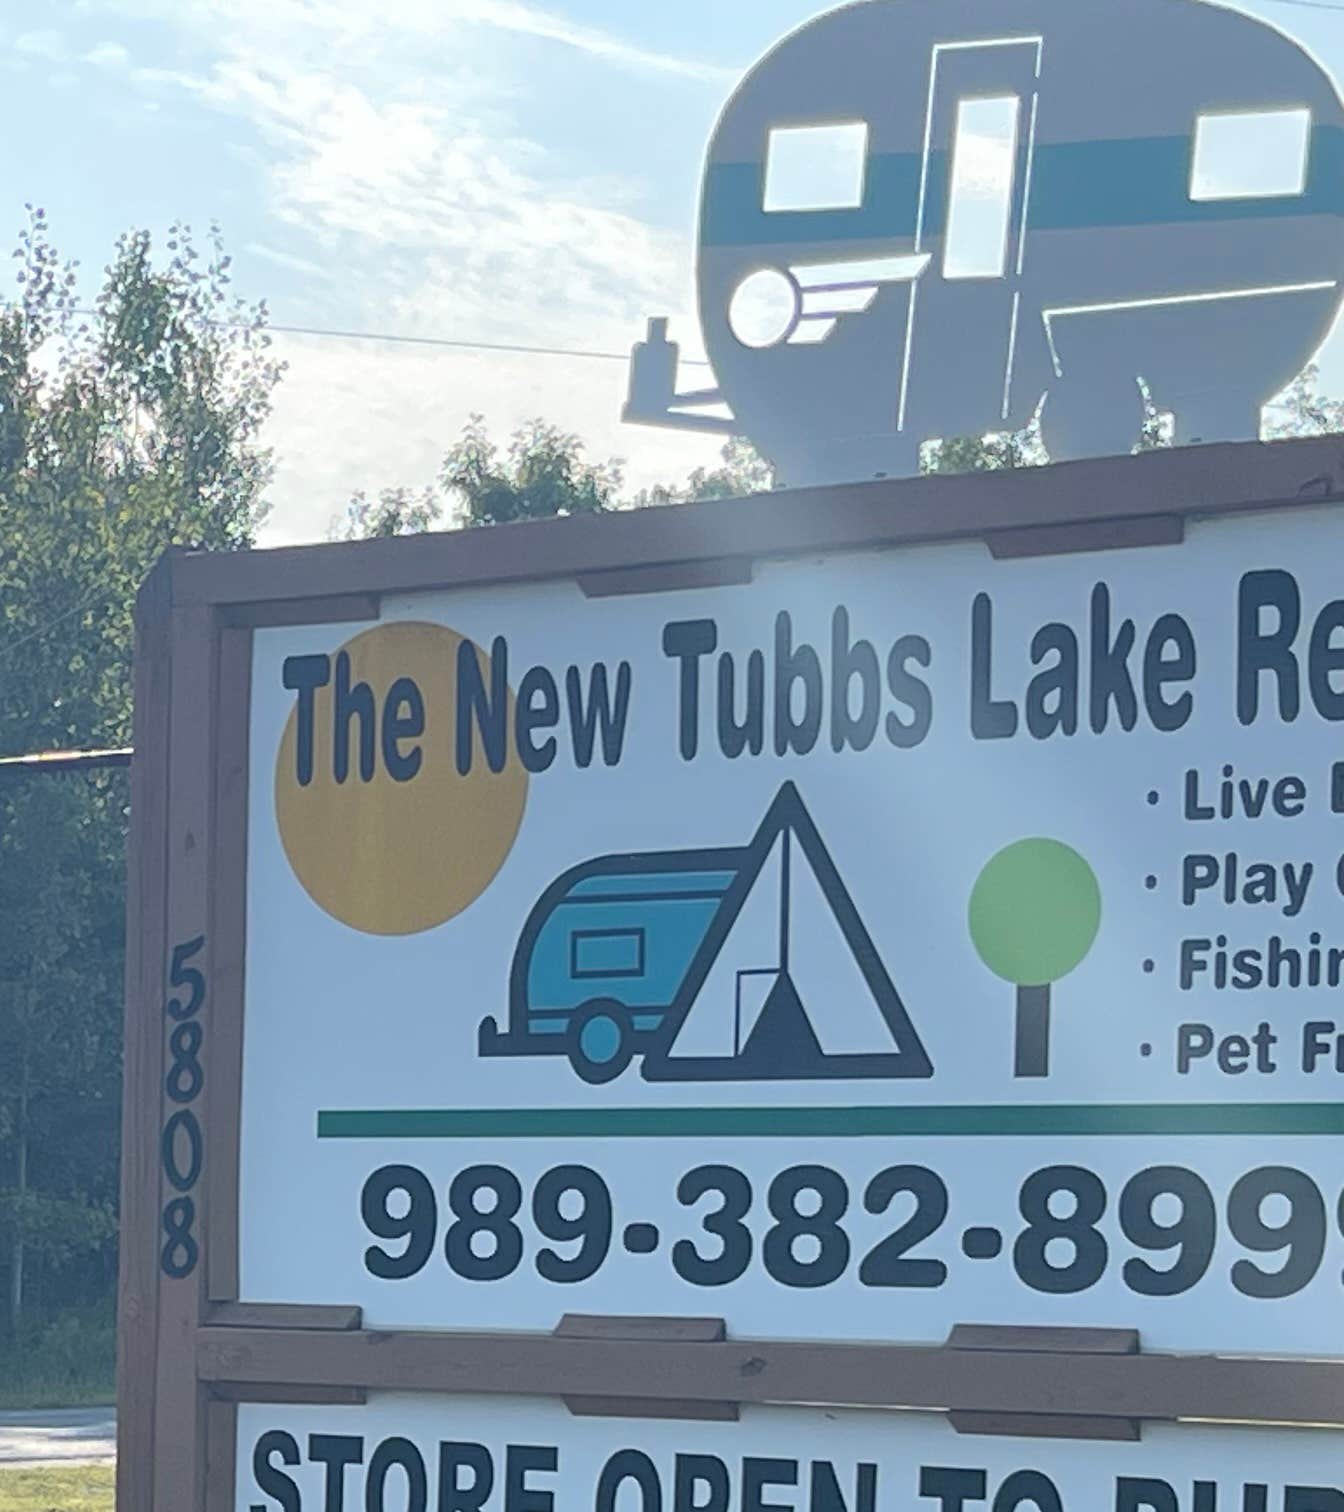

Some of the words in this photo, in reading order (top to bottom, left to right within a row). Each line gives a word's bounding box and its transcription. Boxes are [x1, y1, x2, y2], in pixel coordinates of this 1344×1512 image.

[282, 648, 426, 788] The
[455, 635, 632, 777] New
[661, 604, 933, 762] Tubbs
[970, 581, 1197, 740] Lake
[1236, 568, 1344, 726] Re
[1184, 764, 1307, 821] Live
[1182, 851, 1314, 917] Play
[1177, 1021, 1278, 1075] Pet
[161, 935, 206, 1279] 5808
[360, 1164, 1344, 1299] 989-382-899
